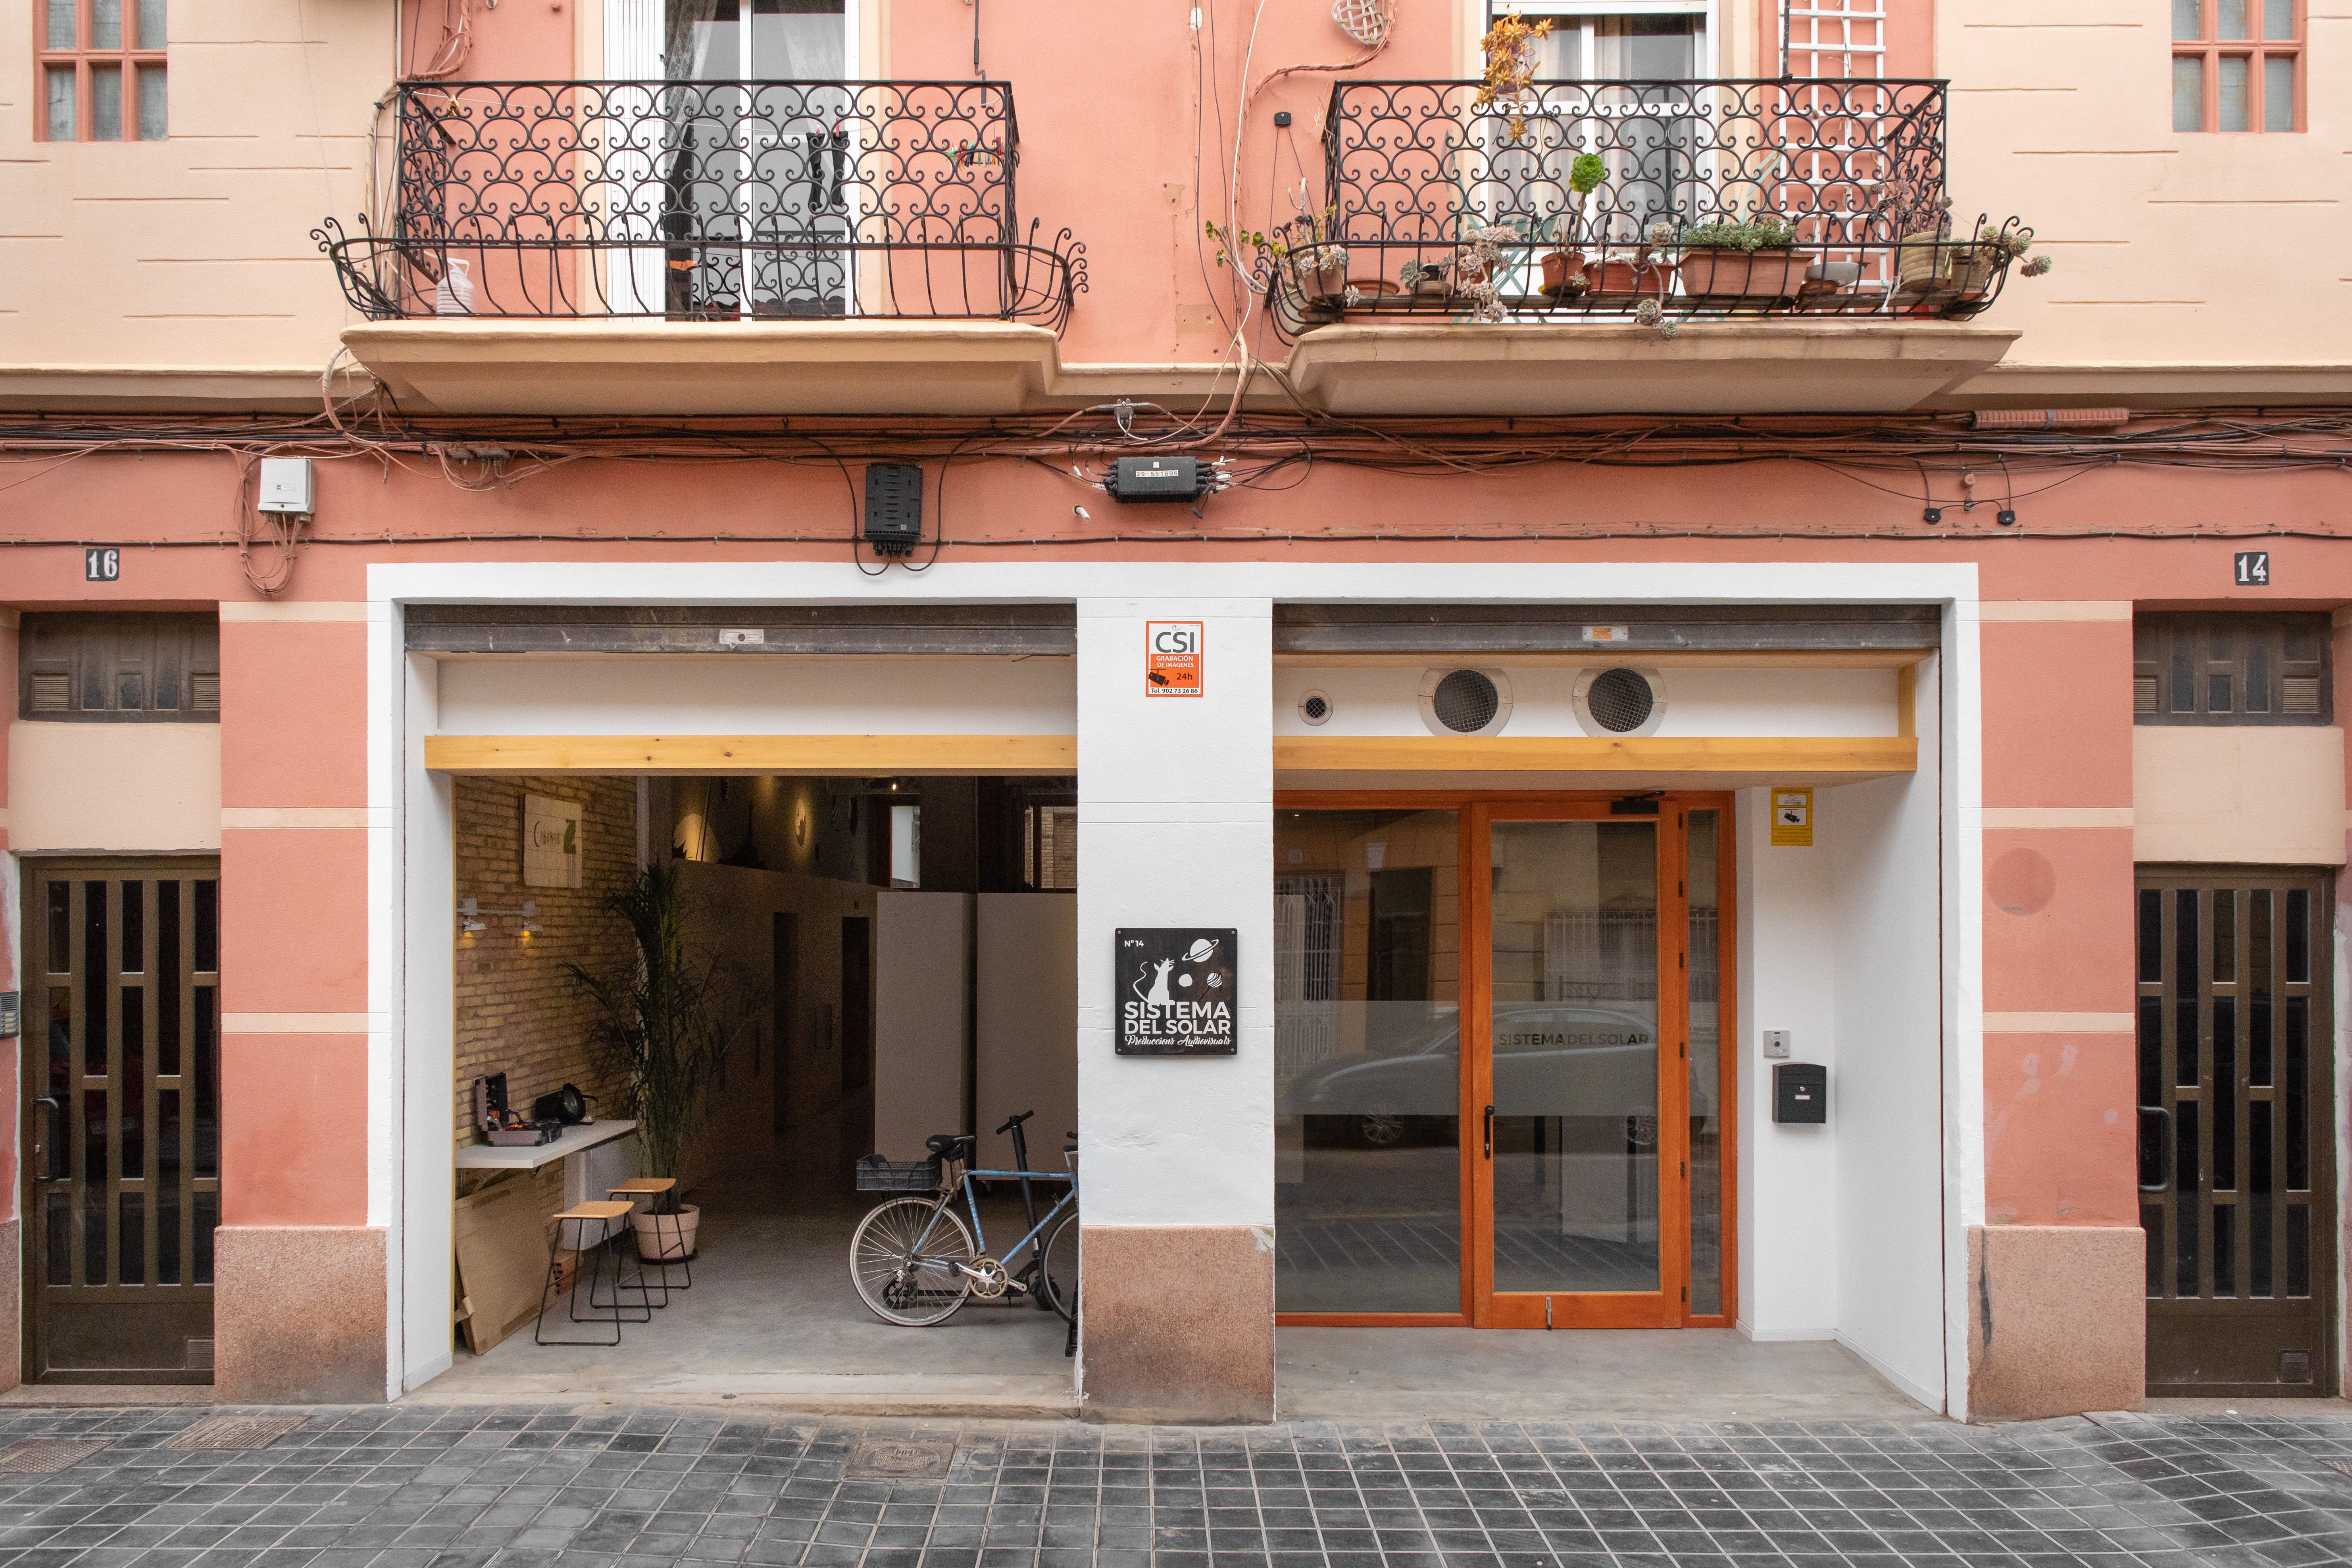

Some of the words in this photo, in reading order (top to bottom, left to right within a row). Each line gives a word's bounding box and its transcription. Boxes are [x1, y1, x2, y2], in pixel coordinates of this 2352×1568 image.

[88, 550, 117, 578] 16
[2238, 555, 2267, 581] 14
[1156, 631, 1194, 653] CSI
[1124, 1000, 1231, 1019] SISTEMA
[1125, 1020, 1162, 1034] DEL
[1165, 1020, 1231, 1034] SOLAR
[1125, 1035, 1175, 1045] Produccions
[1177, 1035, 1231, 1047] Audiovisuals
